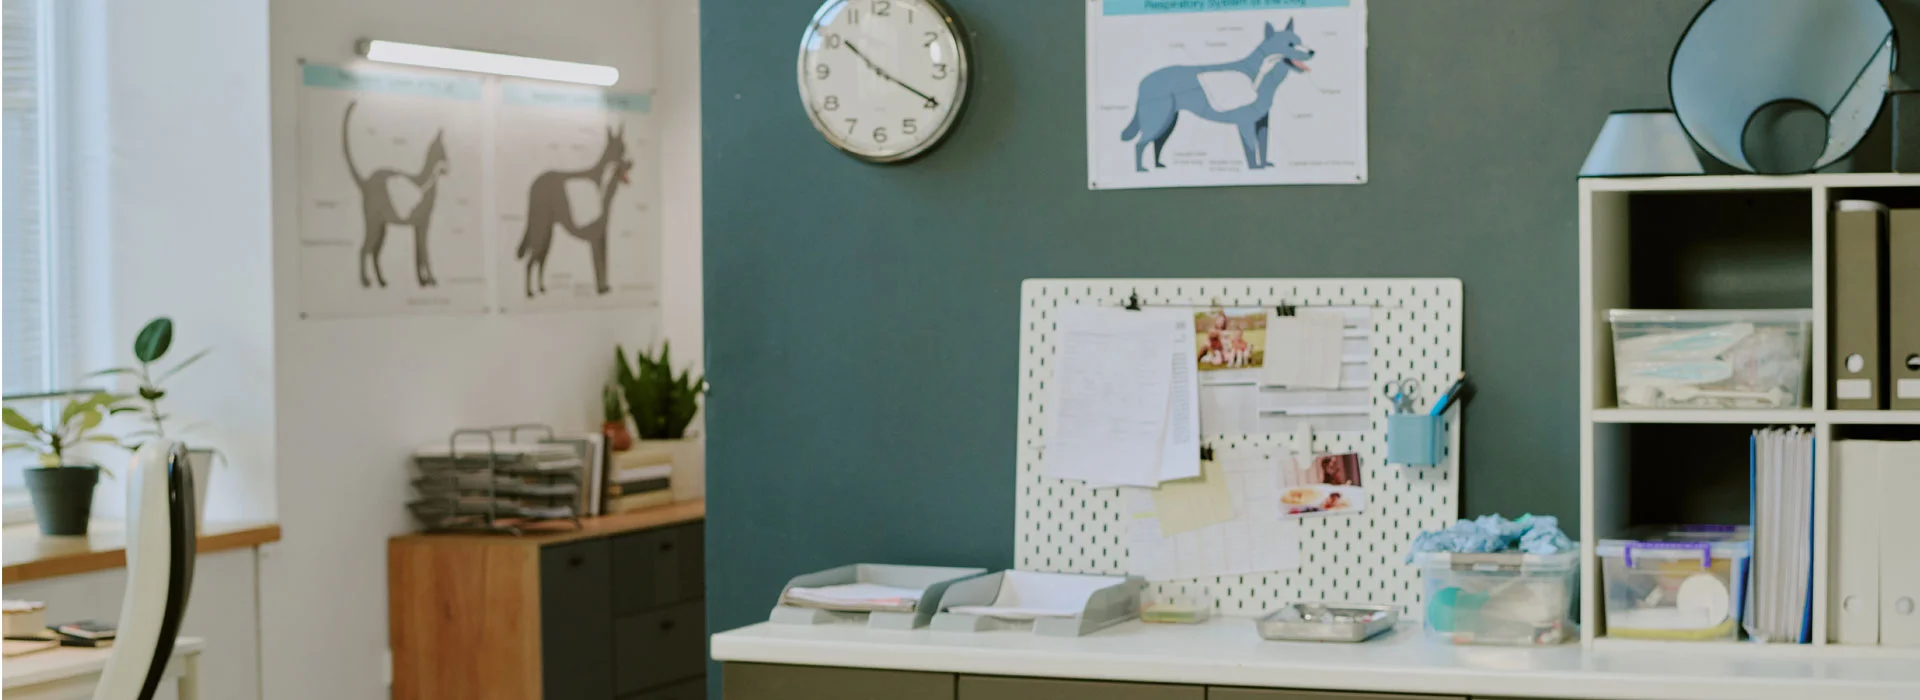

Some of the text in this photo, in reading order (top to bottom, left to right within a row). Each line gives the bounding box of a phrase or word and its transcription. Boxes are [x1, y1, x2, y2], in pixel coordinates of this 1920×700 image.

[871, 0, 891, 16] 12
[848, 9, 859, 25] 11
[824, 34, 841, 49] 10
[923, 31, 939, 49] 2
[816, 63, 830, 80] 9
[931, 63, 947, 80] 3
[823, 95, 840, 111] 8
[844, 117, 858, 135] 7
[872, 126, 888, 143] 6
[902, 118, 917, 135] 5
